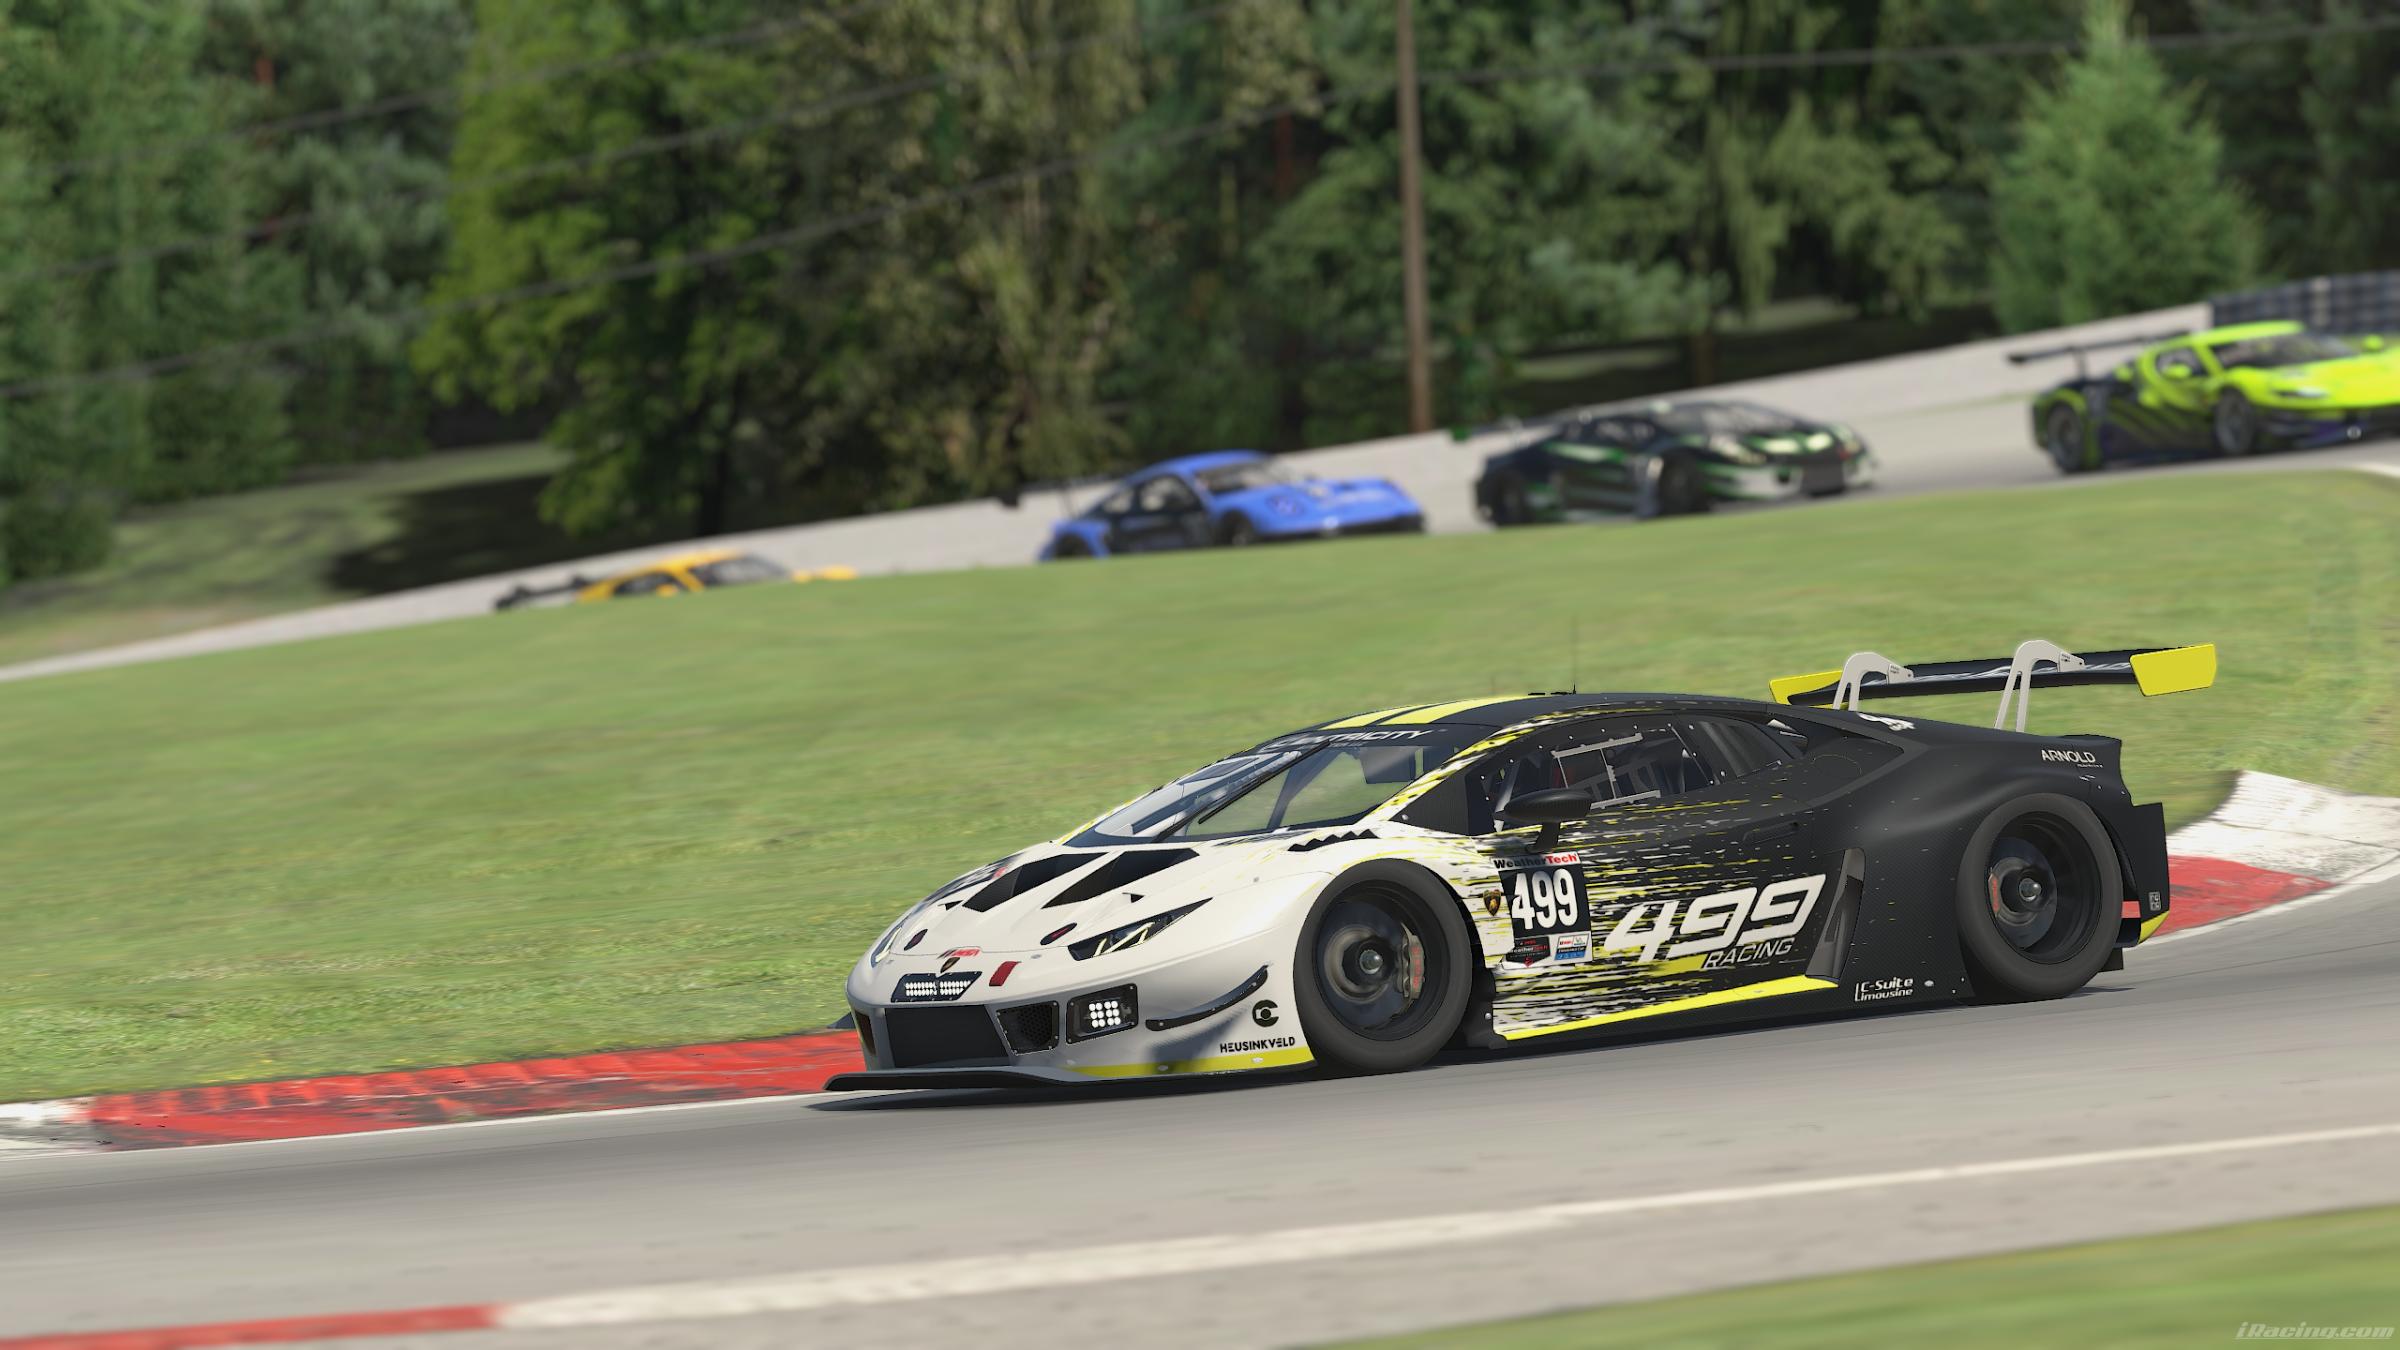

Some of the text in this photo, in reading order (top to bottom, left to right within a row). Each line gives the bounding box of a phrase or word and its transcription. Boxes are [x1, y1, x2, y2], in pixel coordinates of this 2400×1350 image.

[2041, 749, 2096, 763] ARNOLD
[1493, 853, 1577, 869] WeatherTech
[1511, 868, 1578, 930] 499
[1604, 874, 1827, 964] 499
[1703, 937, 1796, 970] RACING
[1860, 976, 1914, 993] C-Suite
[1854, 988, 1914, 1002] Limousine
[1219, 1036, 1296, 1053] HEUSINKVELD
